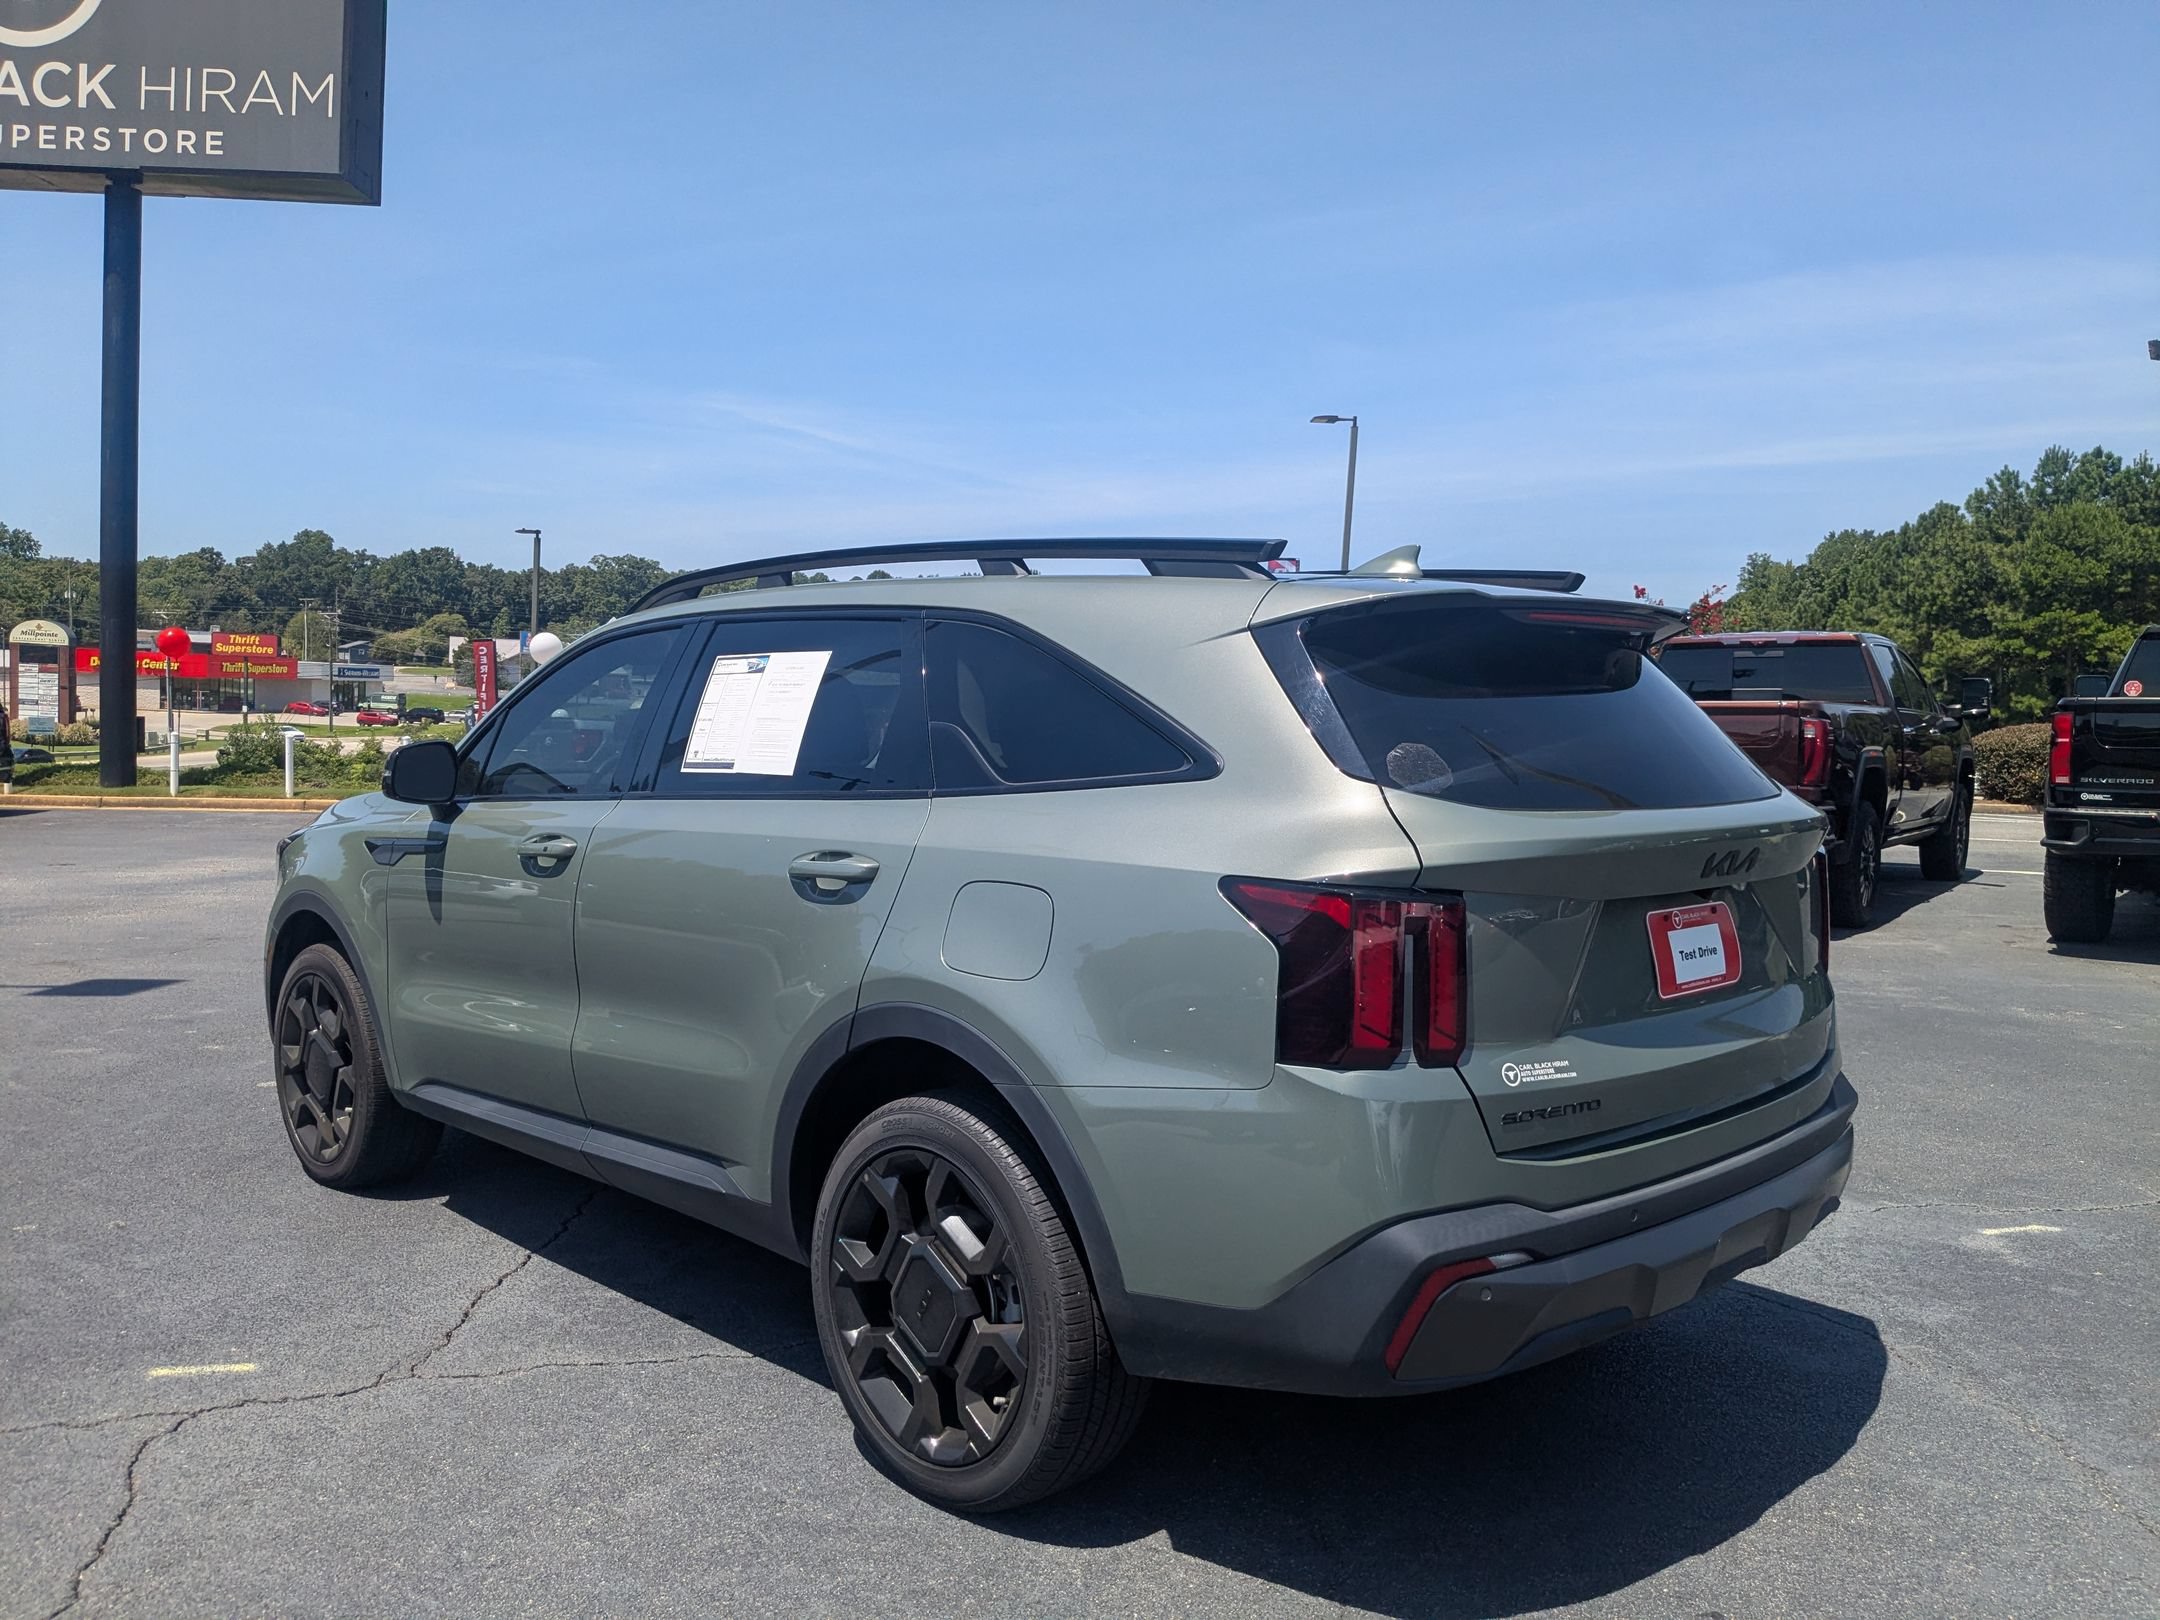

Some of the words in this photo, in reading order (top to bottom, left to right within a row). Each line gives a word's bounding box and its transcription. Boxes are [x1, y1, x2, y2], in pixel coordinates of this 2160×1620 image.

[140, 66, 334, 118] HIRAM
[0, 124, 224, 155] PERSTORE
[20, 630, 59, 638] Millpointe
[229, 634, 260, 645] Thrift
[215, 643, 274, 655] Superstore
[1679, 949, 1697, 962] Test
[1698, 945, 1718, 958] Drive
[1534, 1061, 1552, 1069] BLACK
[1500, 1099, 1601, 1125] SORENTO
